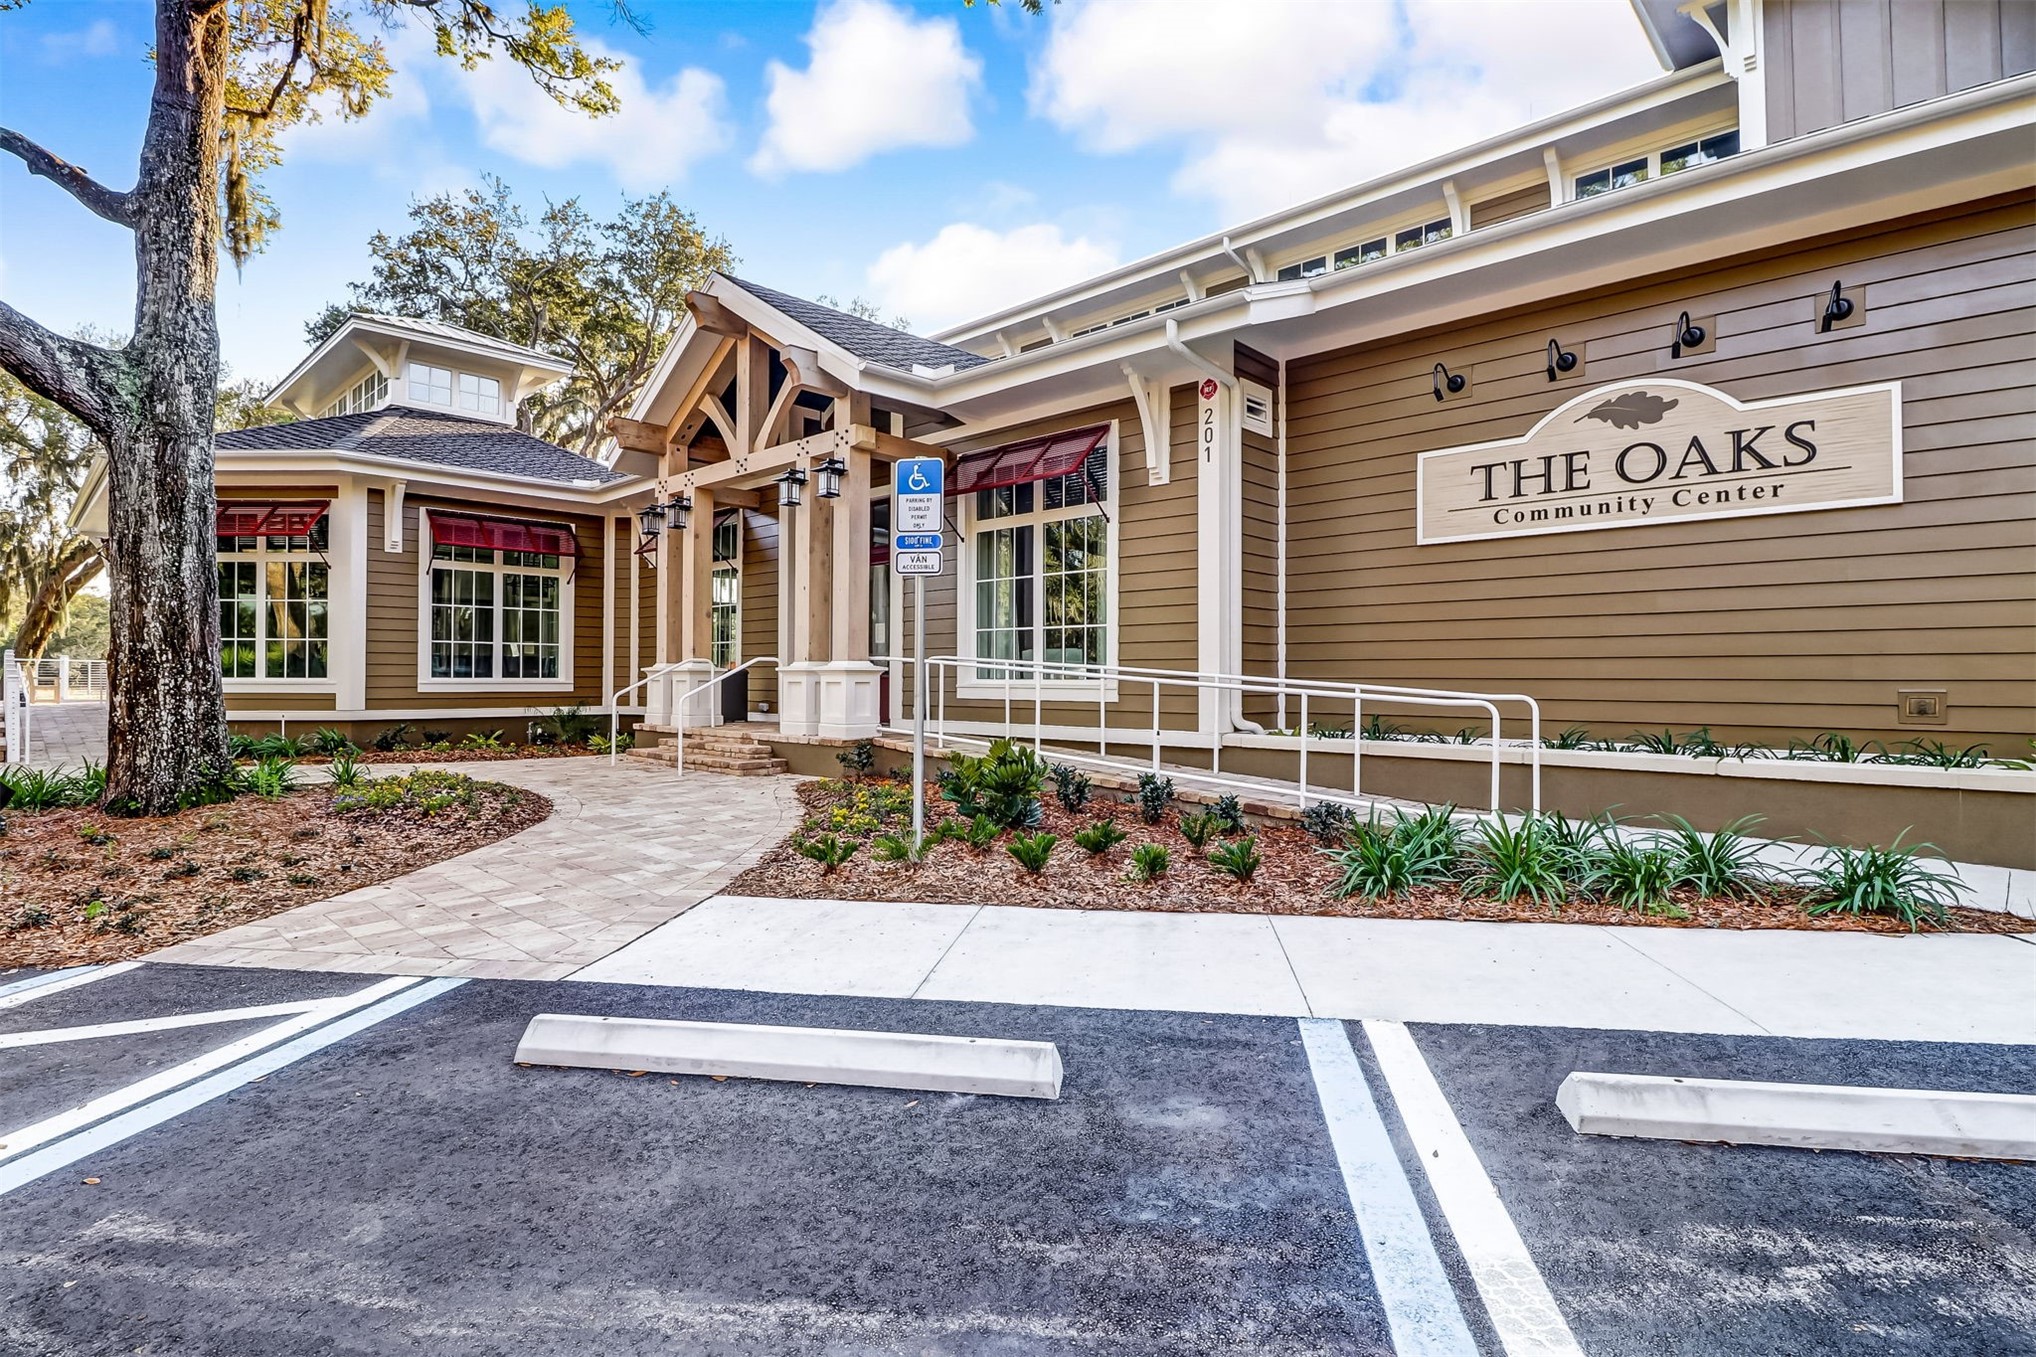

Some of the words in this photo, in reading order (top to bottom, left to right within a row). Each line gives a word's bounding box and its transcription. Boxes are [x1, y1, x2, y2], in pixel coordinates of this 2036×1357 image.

[1204, 408, 1213, 462] 201
[1470, 450, 1591, 502] THE
[1614, 419, 1817, 484] OAKS
[1493, 493, 1656, 526] Community
[1671, 483, 1785, 508] Center
[910, 555, 928, 563] VAN
[919, 536, 933, 544] FINE
